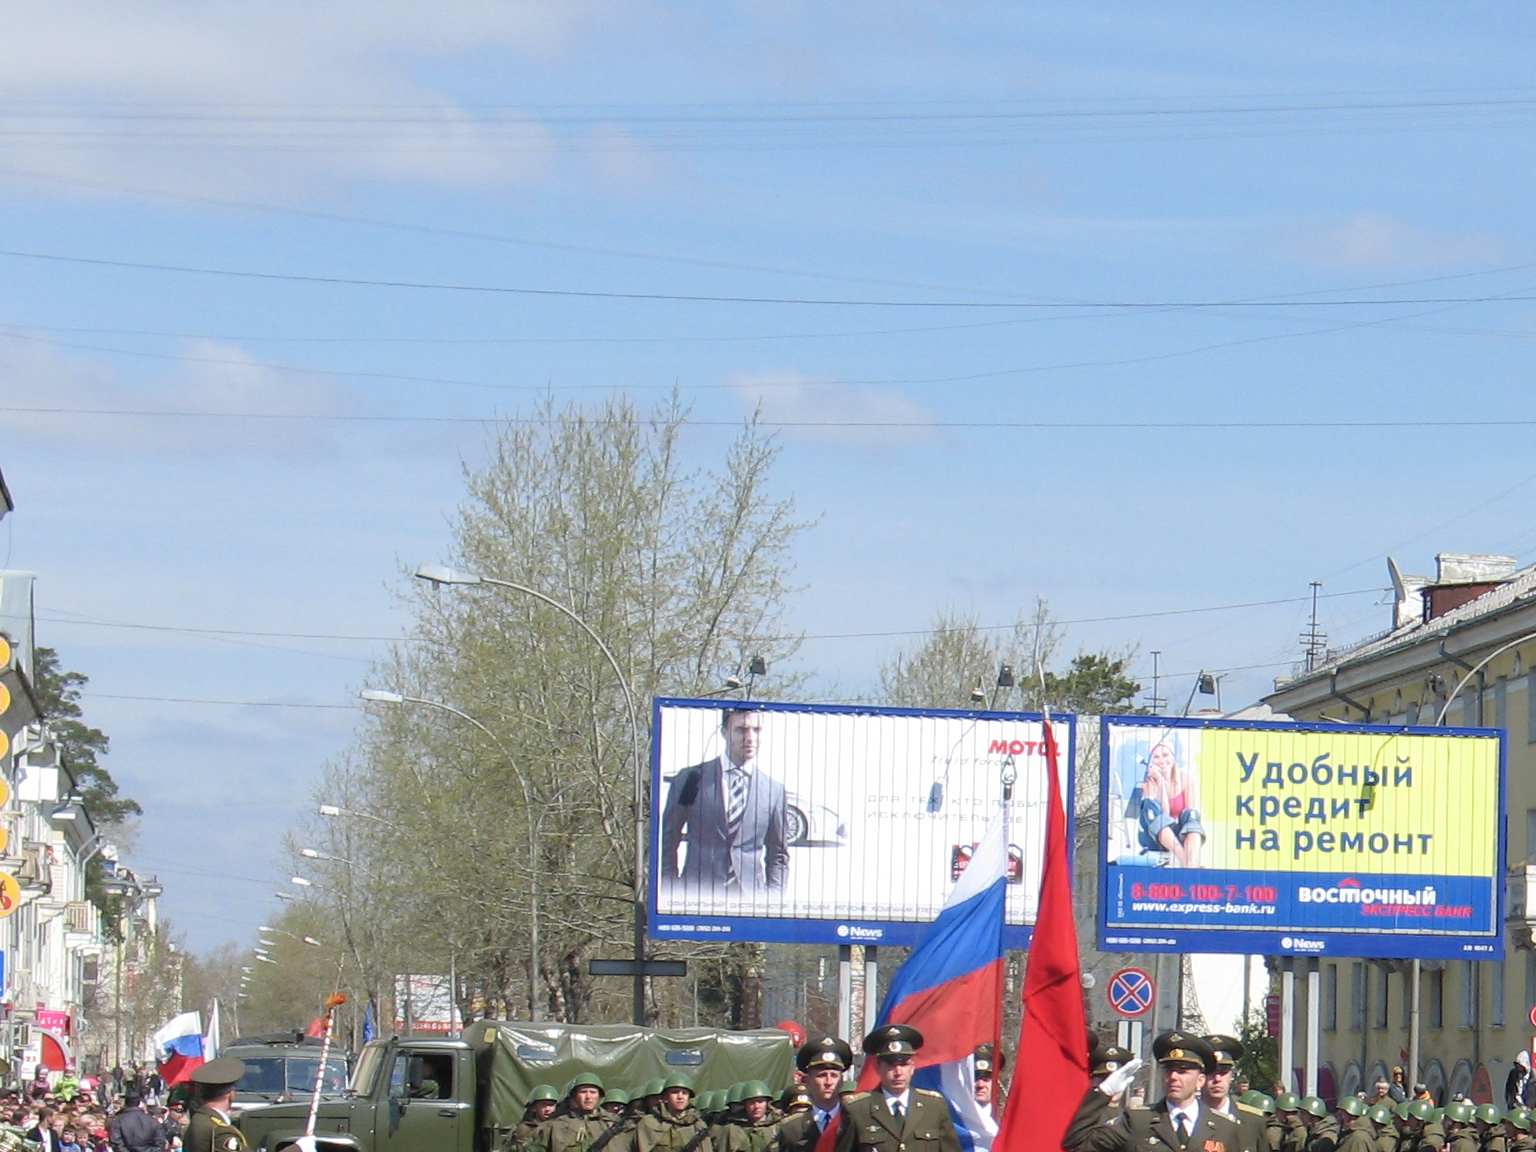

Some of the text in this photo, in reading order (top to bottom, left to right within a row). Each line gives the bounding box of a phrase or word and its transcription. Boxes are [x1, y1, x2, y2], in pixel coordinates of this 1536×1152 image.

[1236, 752, 1412, 789] Удобный
[1236, 795, 1370, 825] кредит
[1236, 828, 1433, 860] на ремонт
[1131, 883, 1278, 903] 8-800-100-7-100
[1131, 901, 1277, 915] www.express-bank.ru
[1360, 904, 1474, 918] ЭКСПРЕСС БАНК
[850, 926, 883, 937] News
[1294, 938, 1325, 949] News
